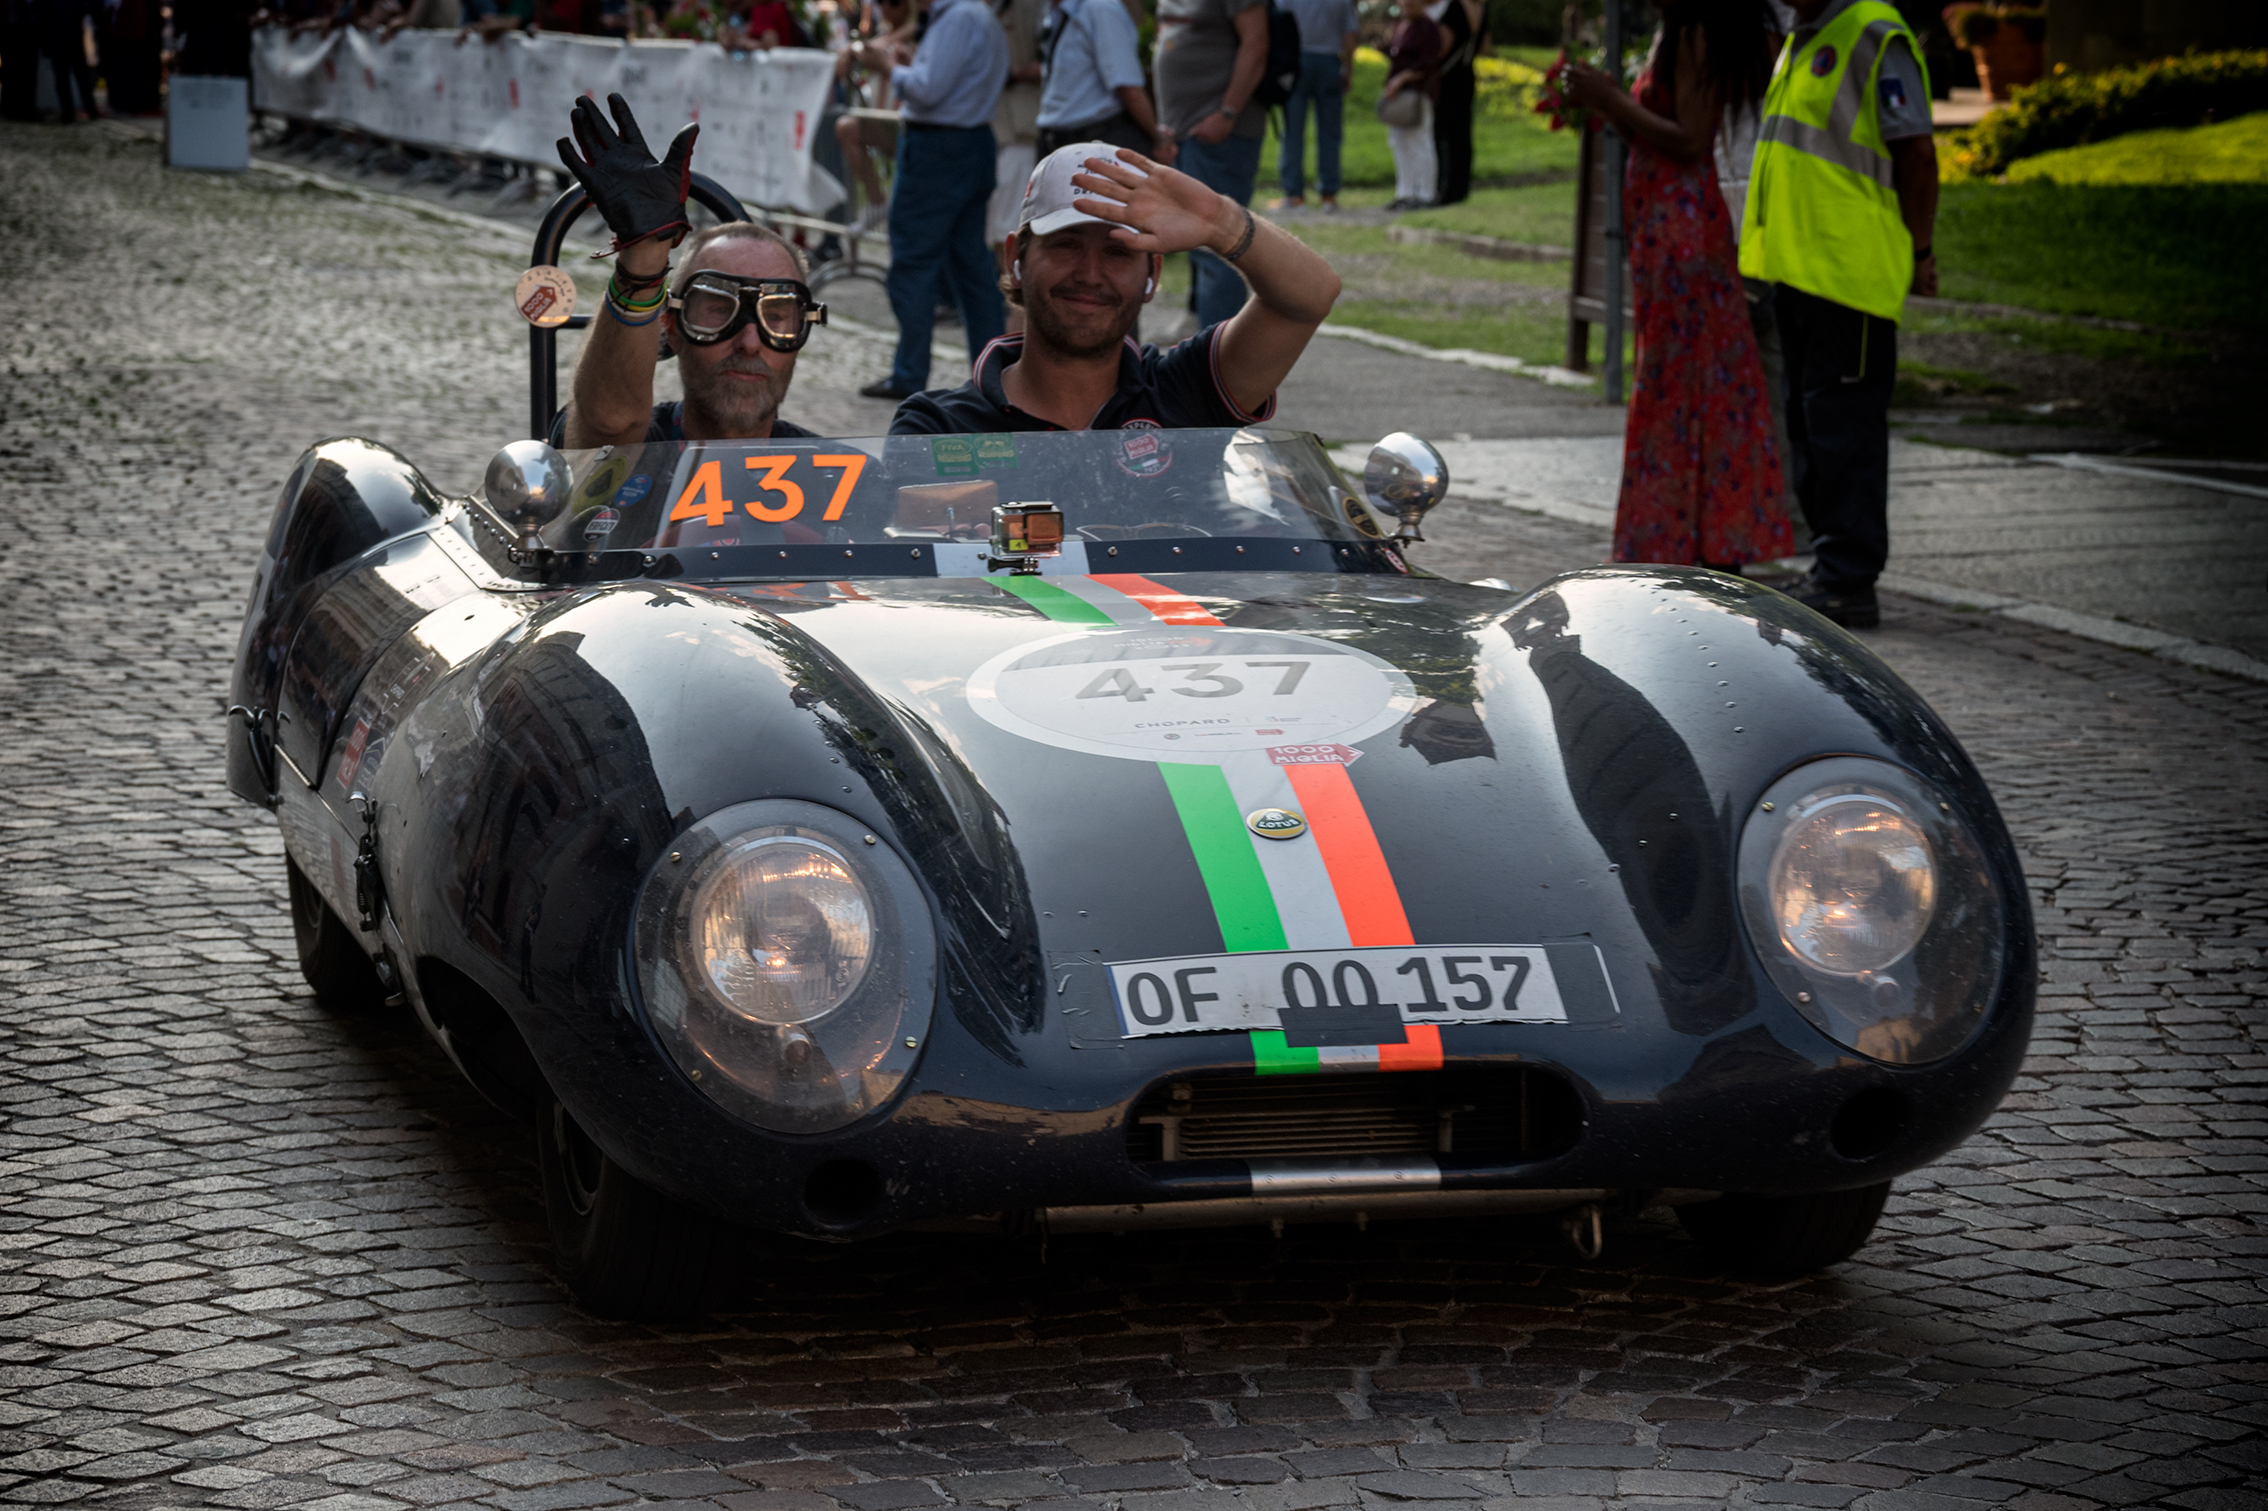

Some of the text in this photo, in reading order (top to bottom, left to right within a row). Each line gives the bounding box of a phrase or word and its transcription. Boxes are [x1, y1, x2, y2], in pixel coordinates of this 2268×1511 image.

[669, 454, 867, 527] 437
[1075, 661, 1311, 703] 437
[1134, 718, 1231, 729] CHOPARD
[1273, 745, 1335, 755] 1000
[1274, 754, 1345, 763] MIGLIA
[1257, 818, 1300, 829] LOTUS
[1126, 966, 1220, 1027] OF
[1395, 955, 1531, 1013] 157
